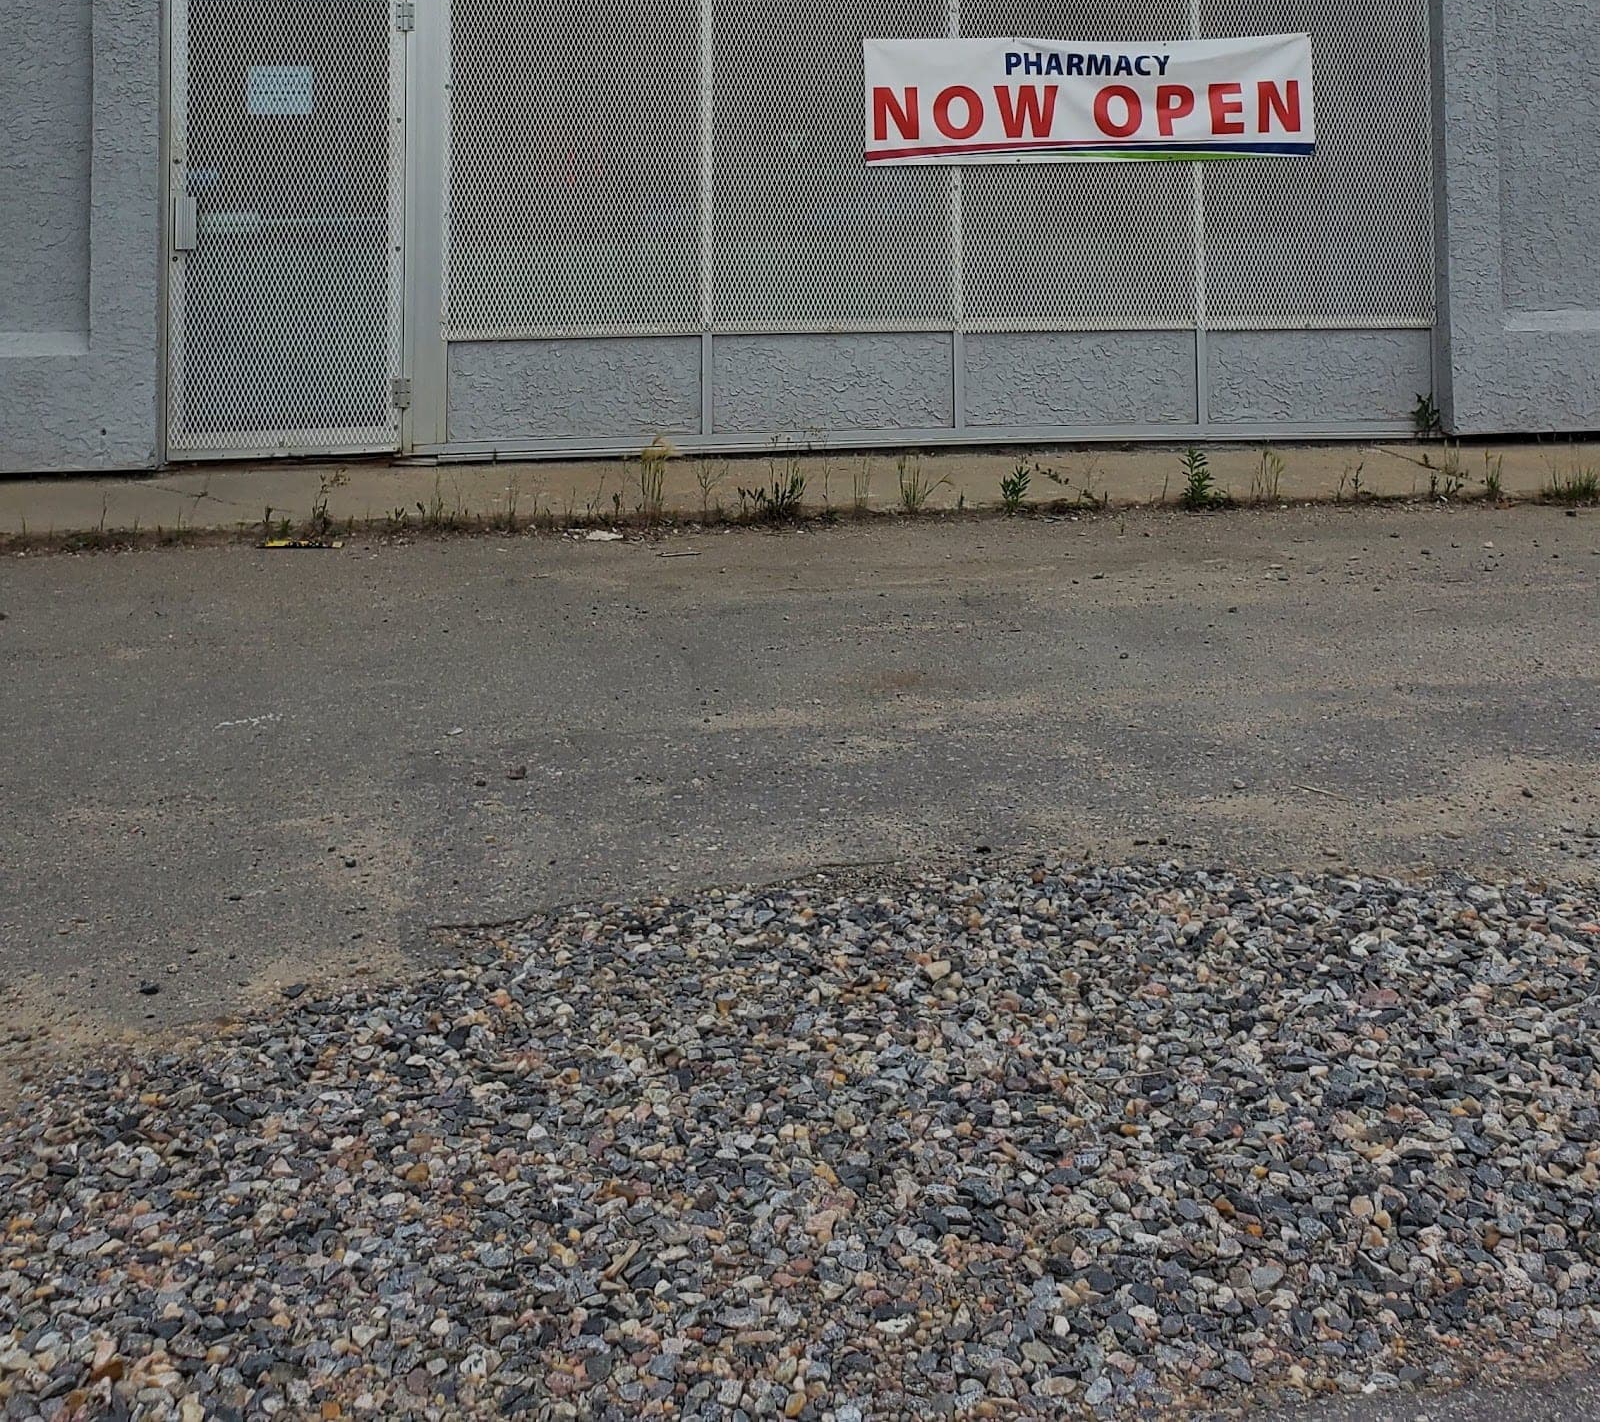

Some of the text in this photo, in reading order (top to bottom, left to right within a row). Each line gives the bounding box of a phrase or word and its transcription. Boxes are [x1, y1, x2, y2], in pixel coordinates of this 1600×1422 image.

[1004, 51, 1171, 77] PHARMACY
[871, 79, 1302, 141] NOW OPEN
